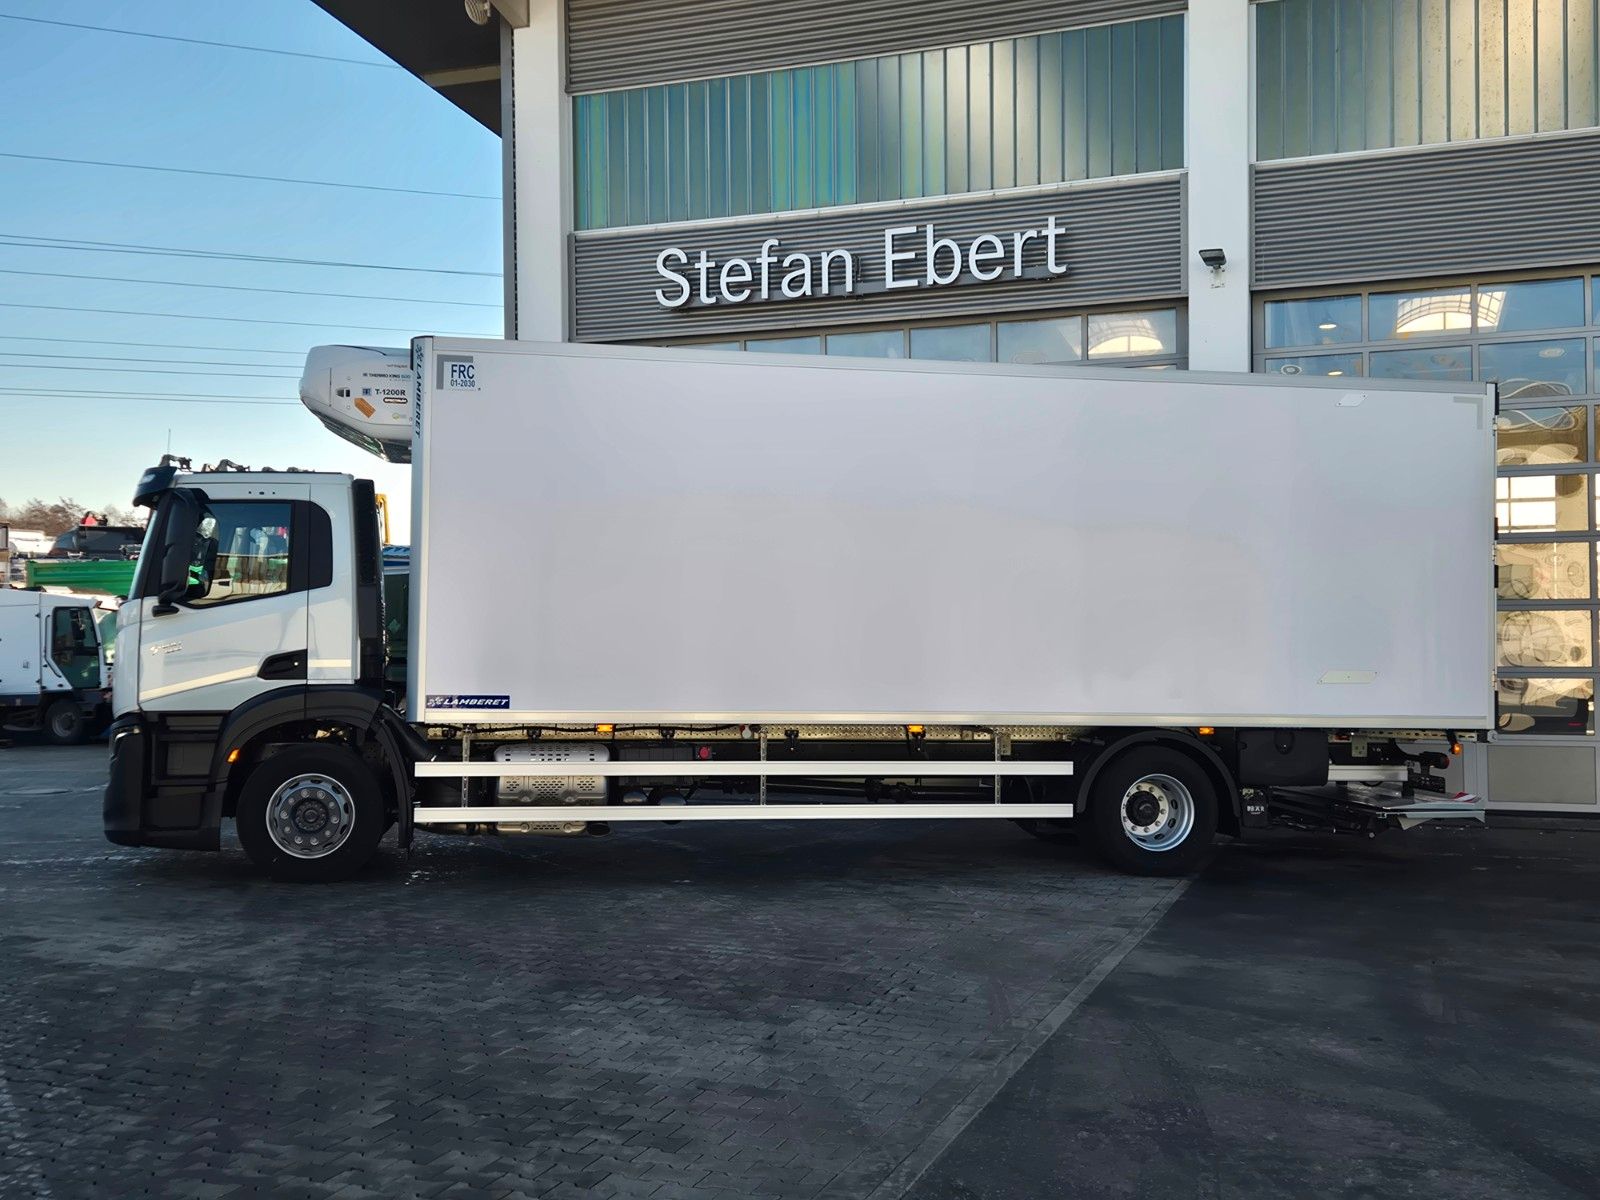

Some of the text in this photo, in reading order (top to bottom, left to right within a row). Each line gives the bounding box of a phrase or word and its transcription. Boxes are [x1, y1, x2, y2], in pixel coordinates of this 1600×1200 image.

[654, 215, 1068, 308] Stefan Ebert
[451, 364, 475, 379] FRC
[450, 379, 476, 387] 01-2030
[375, 388, 406, 396] T-1200R
